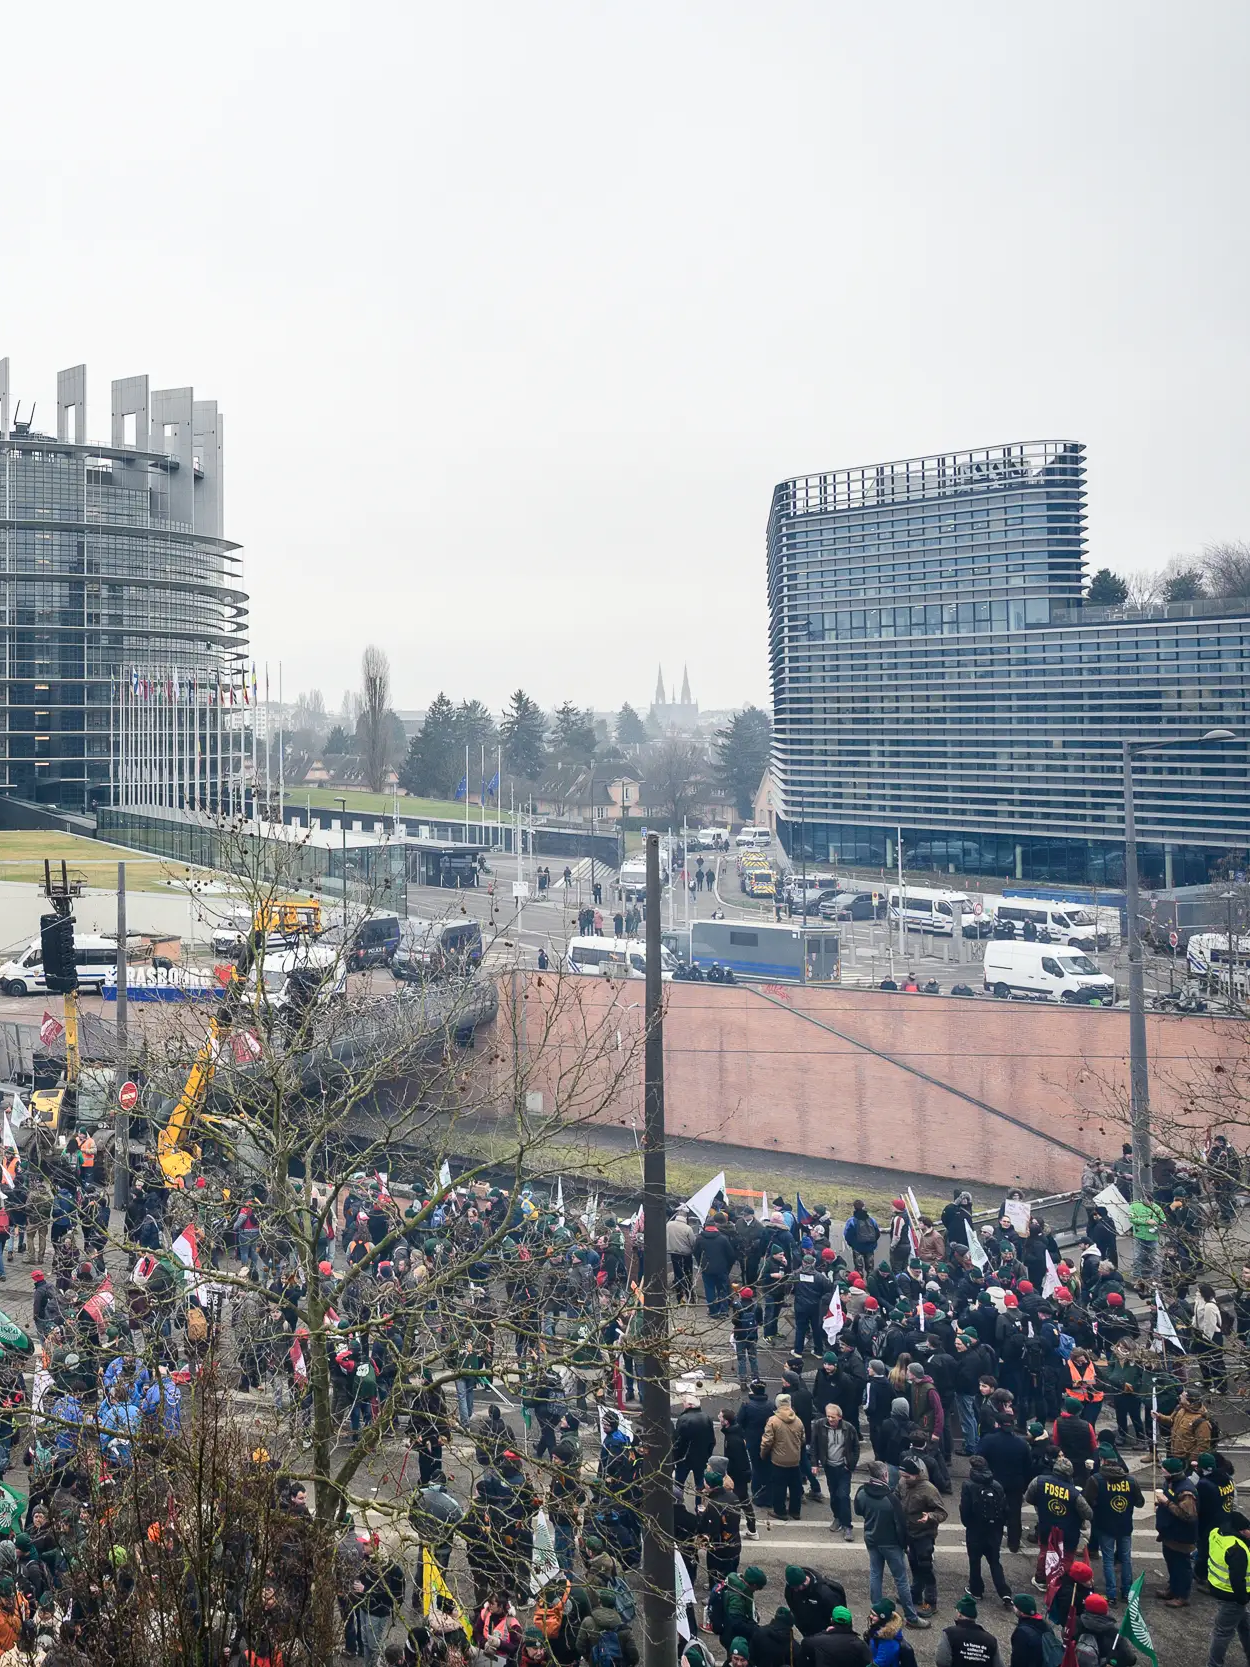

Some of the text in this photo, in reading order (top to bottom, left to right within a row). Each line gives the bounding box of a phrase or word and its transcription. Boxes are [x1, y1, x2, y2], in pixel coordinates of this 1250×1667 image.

[104, 966, 212, 986] SRASBOURG
[1044, 1482, 1070, 1501] FDSEA
[1107, 1481, 1130, 1492] FDSEA
